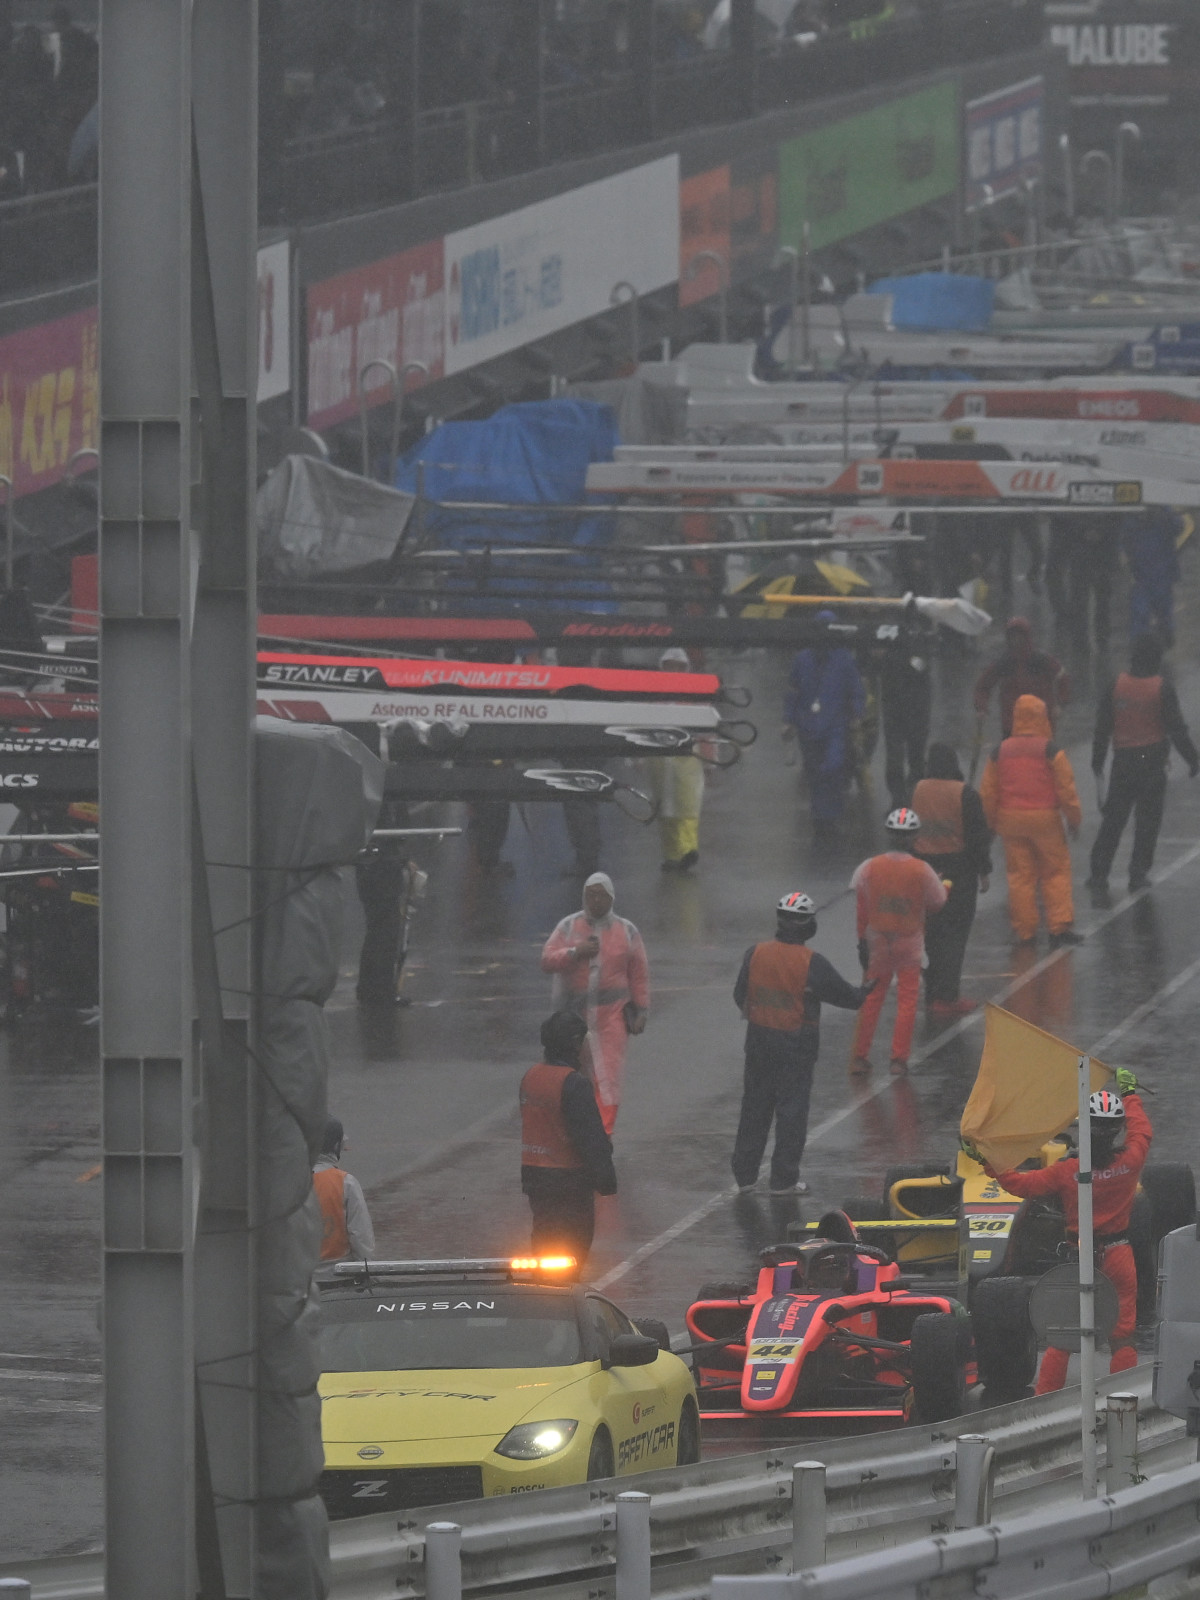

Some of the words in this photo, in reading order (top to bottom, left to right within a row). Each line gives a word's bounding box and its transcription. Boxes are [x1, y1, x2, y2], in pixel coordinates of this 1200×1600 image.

[1009, 469, 1064, 493] au
[39, 665, 88, 675] HONDA
[264, 666, 378, 683] STANLEY
[420, 670, 550, 686] KUNIMITSU
[371, 703, 429, 717] Astemo
[483, 705, 548, 719] RACING
[1074, 1165, 1130, 1182] FICIAL
[969, 1221, 1006, 1231] 30
[376, 1301, 495, 1313] NISSAN
[752, 1345, 795, 1357] 44
[351, 1480, 388, 1498] Z
